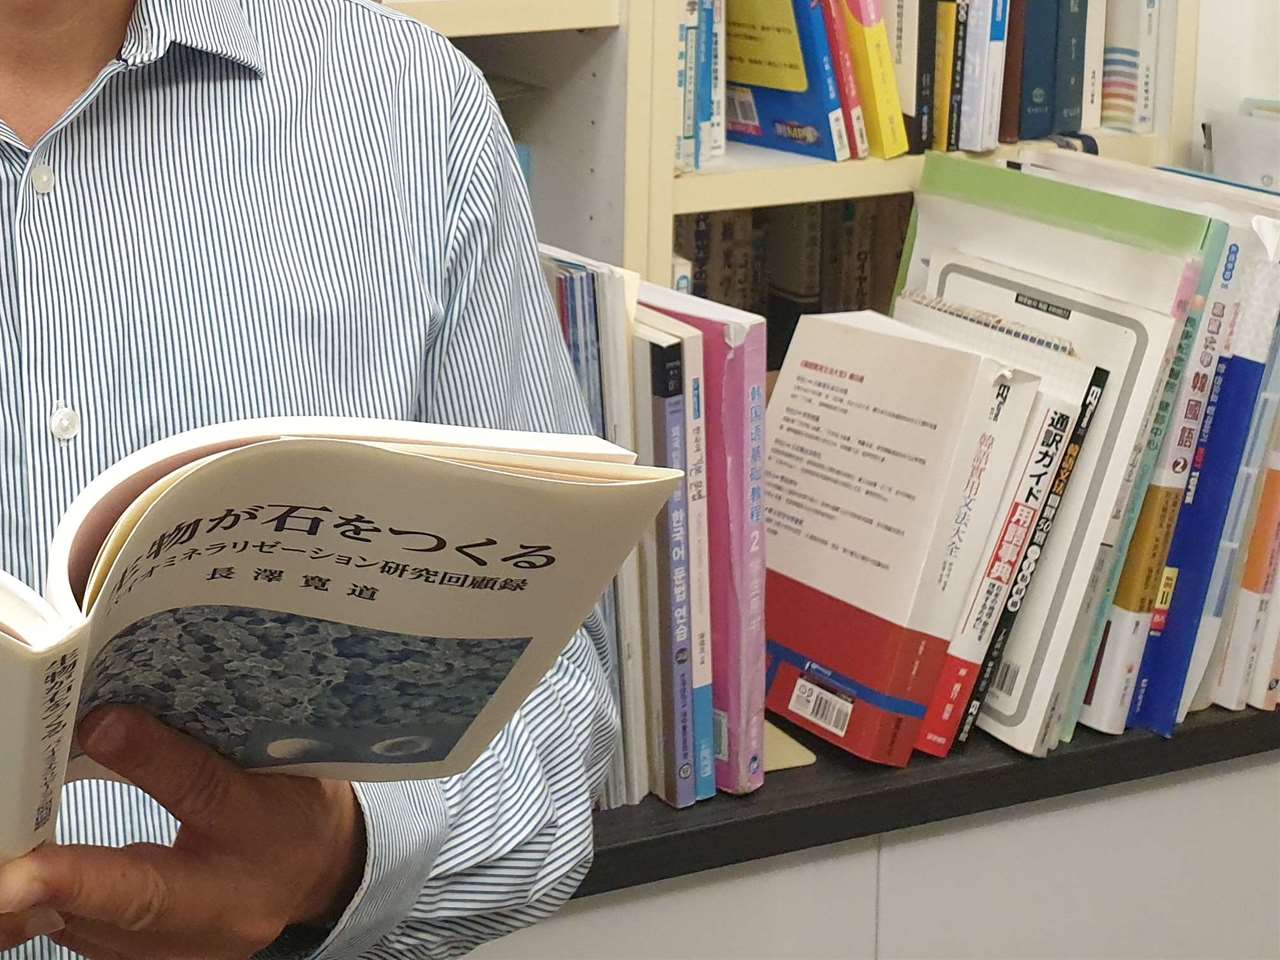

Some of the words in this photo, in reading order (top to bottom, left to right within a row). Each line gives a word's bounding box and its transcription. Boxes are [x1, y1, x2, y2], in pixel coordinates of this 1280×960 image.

[1024, 410, 1070, 504] 通訳ガイド
[1172, 456, 1188, 474] 2
[749, 531, 760, 552] 2
